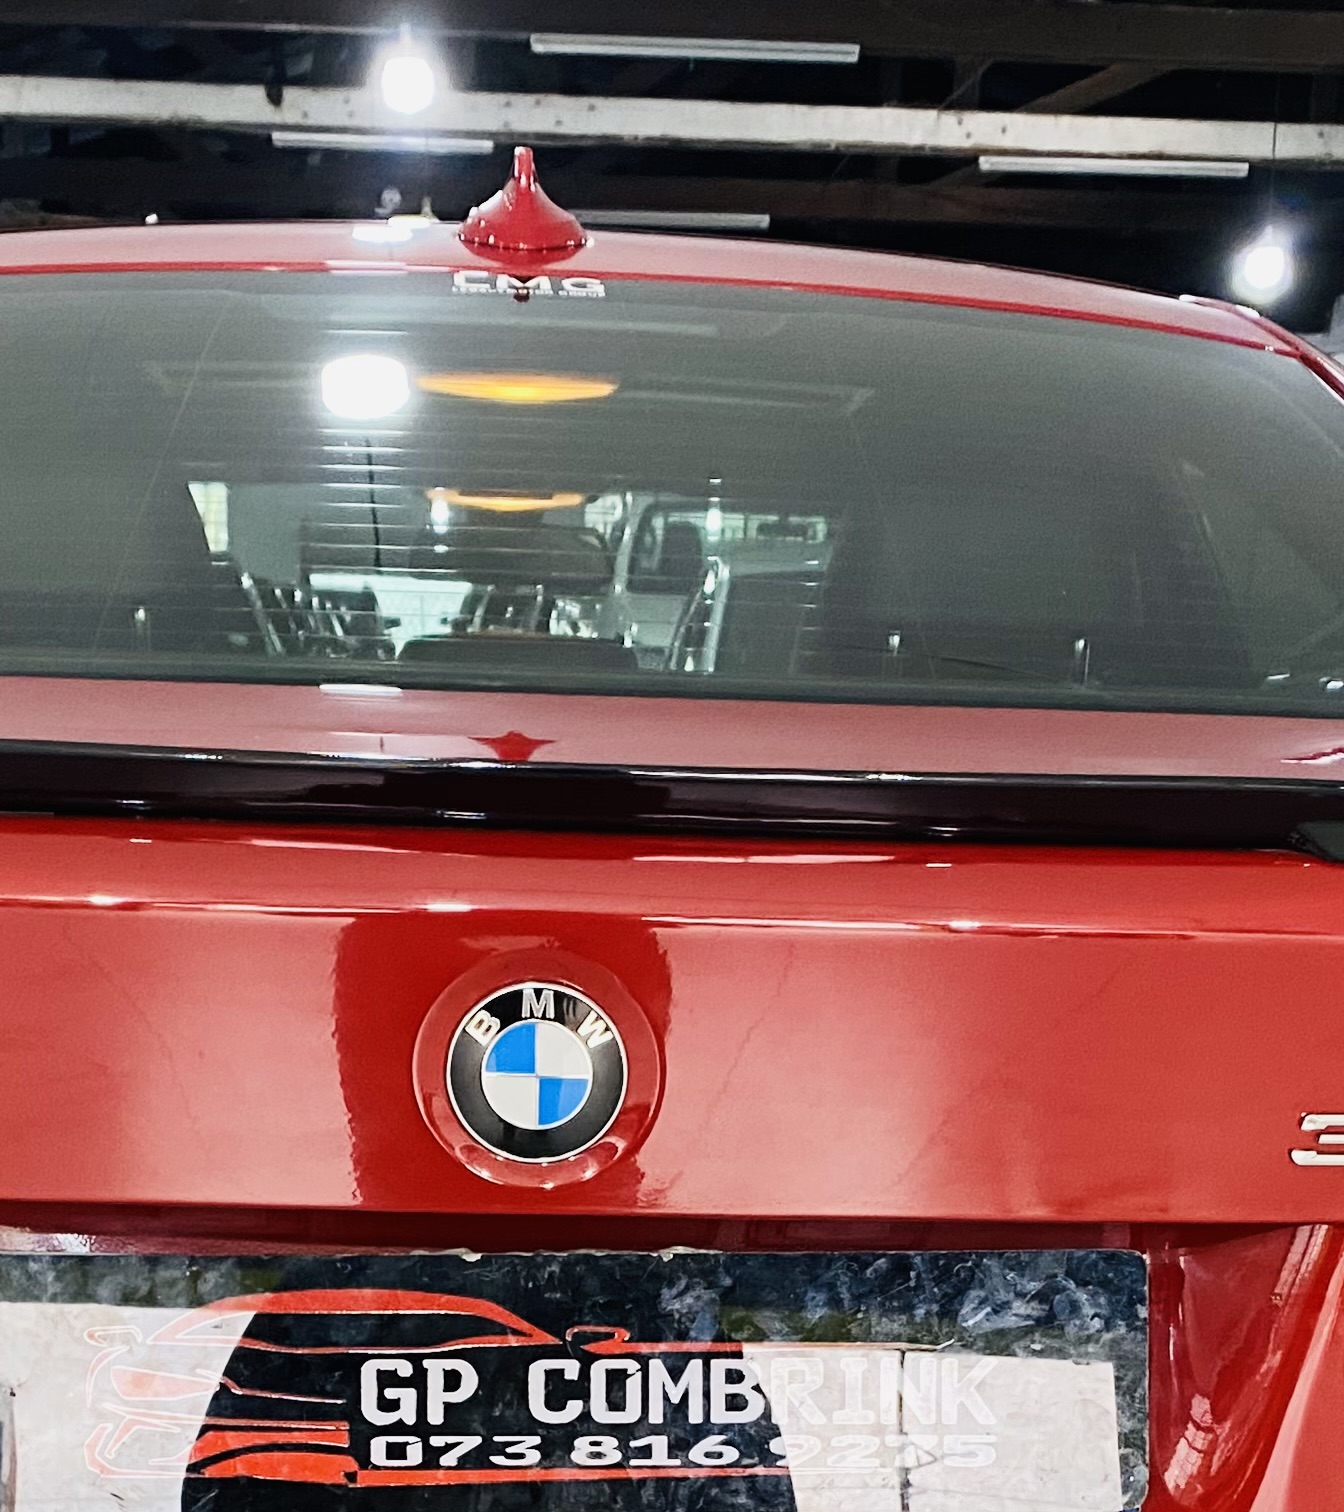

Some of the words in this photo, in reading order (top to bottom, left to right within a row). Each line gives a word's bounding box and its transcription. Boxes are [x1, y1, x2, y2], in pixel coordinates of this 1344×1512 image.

[465, 989, 613, 1048] BMW
[360, 1358, 479, 1426] GP
[527, 1357, 998, 1425] COMBRINK
[369, 1435, 542, 1467] 073
[570, 1434, 741, 1466] 816
